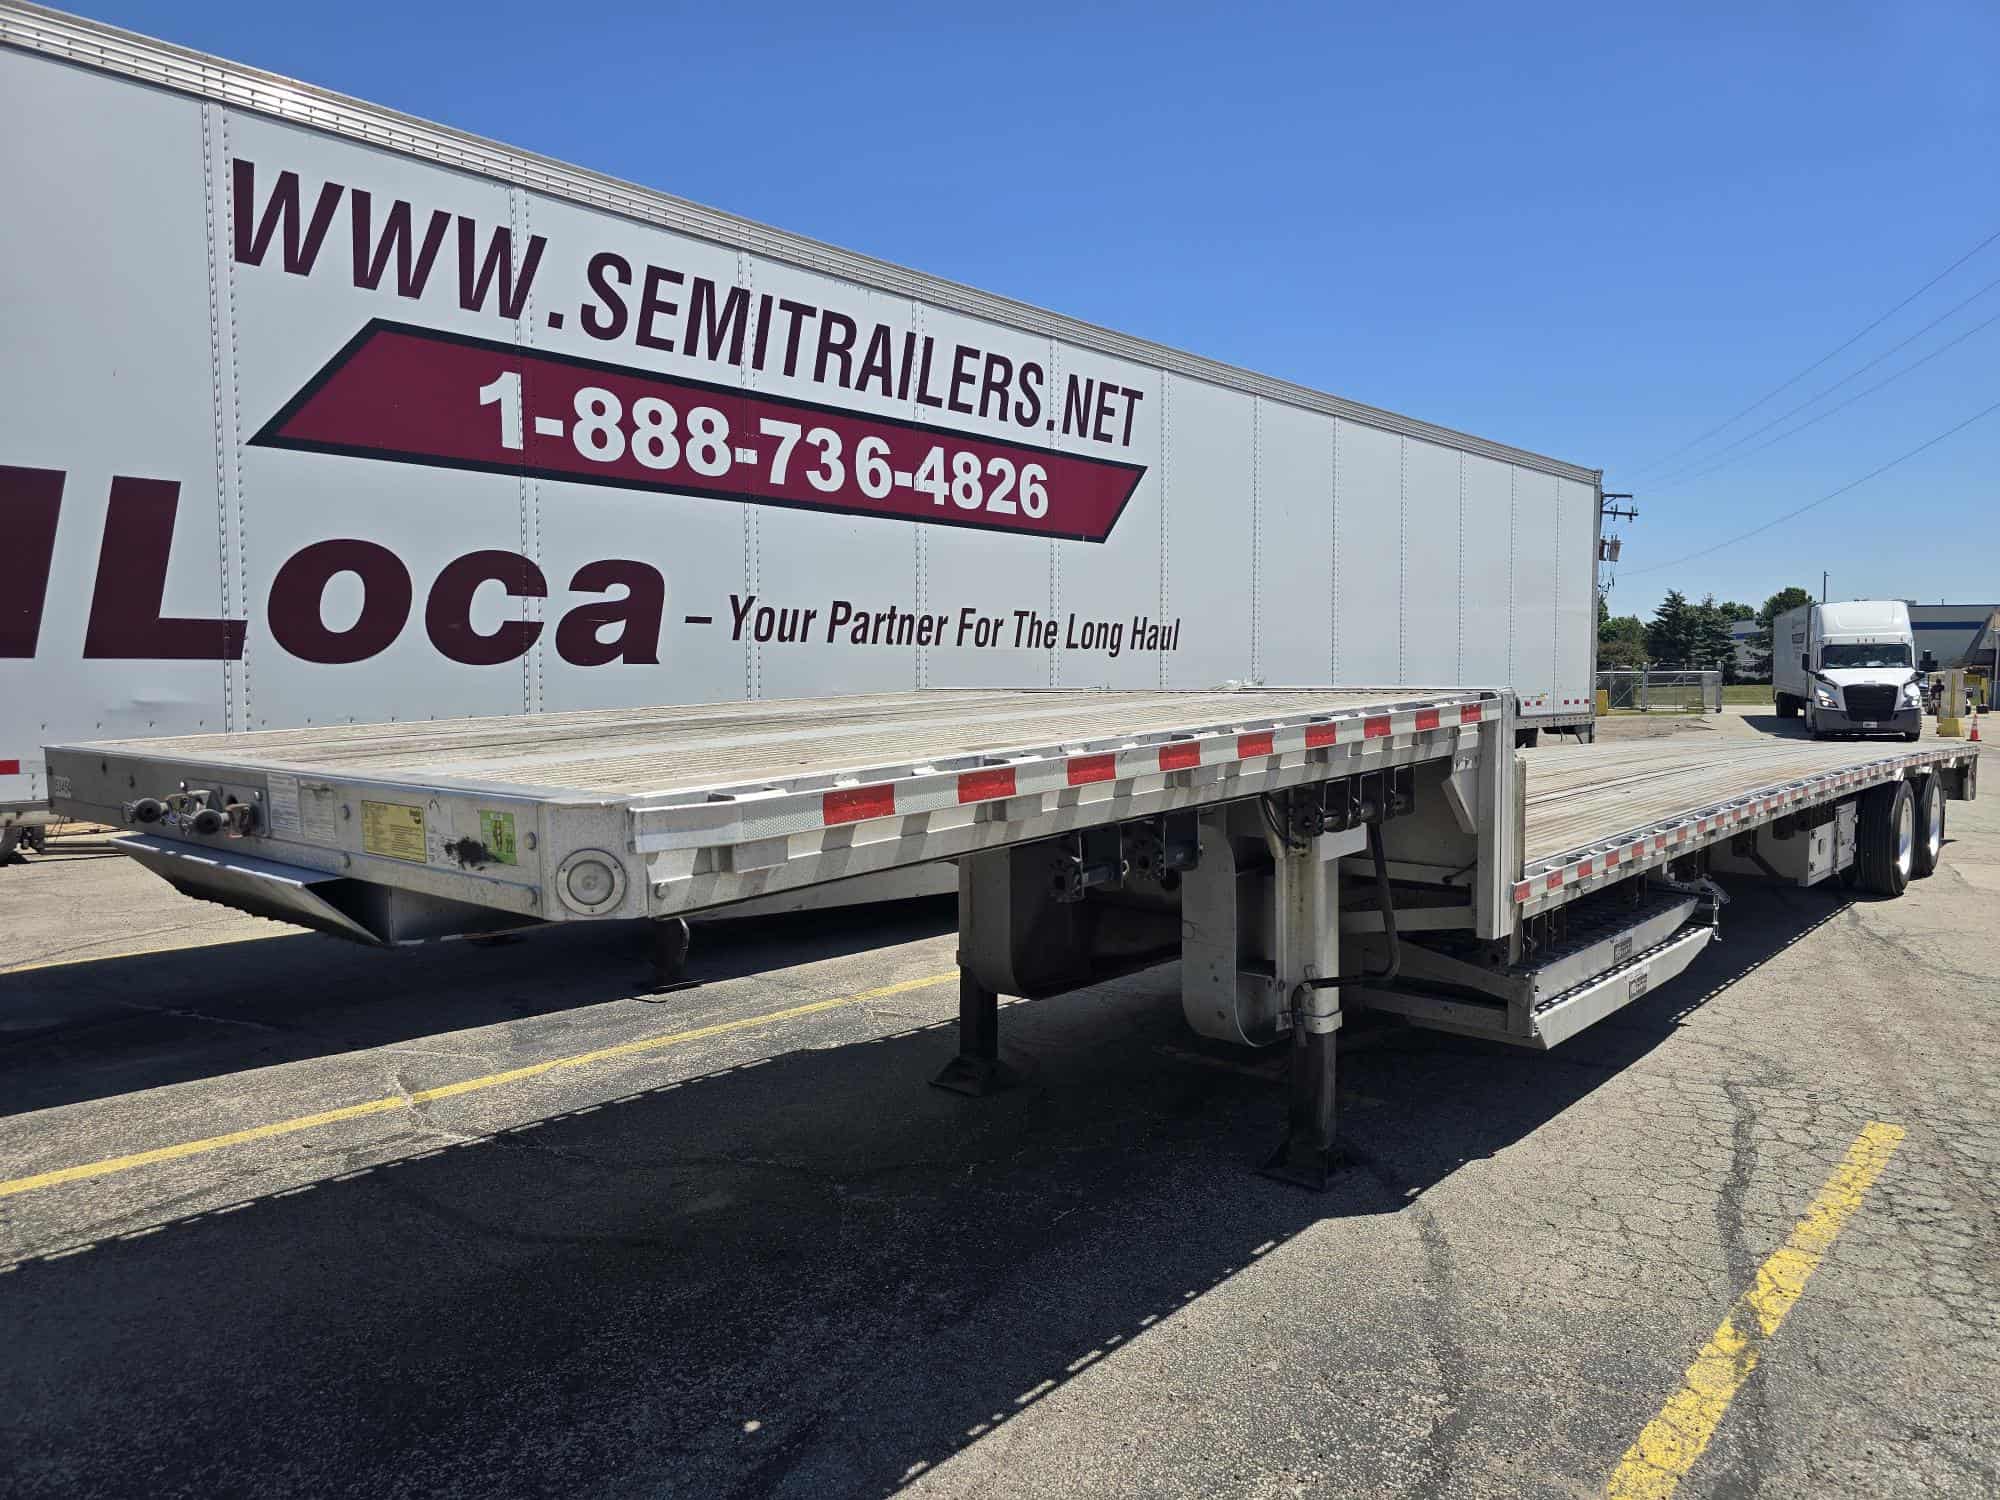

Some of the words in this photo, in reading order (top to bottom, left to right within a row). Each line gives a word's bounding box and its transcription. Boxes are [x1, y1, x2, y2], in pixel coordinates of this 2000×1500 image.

[232, 157, 1144, 447] WWW.SEMITRAILERS.NET
[479, 371, 1049, 519] 1-888-736-4826
[729, 594, 818, 643] Your
[826, 600, 949, 648] Partner
[956, 607, 1005, 648] For
[1013, 610, 1058, 650] The
[1065, 613, 1124, 658] Long
[1129, 615, 1181, 651] Haul
